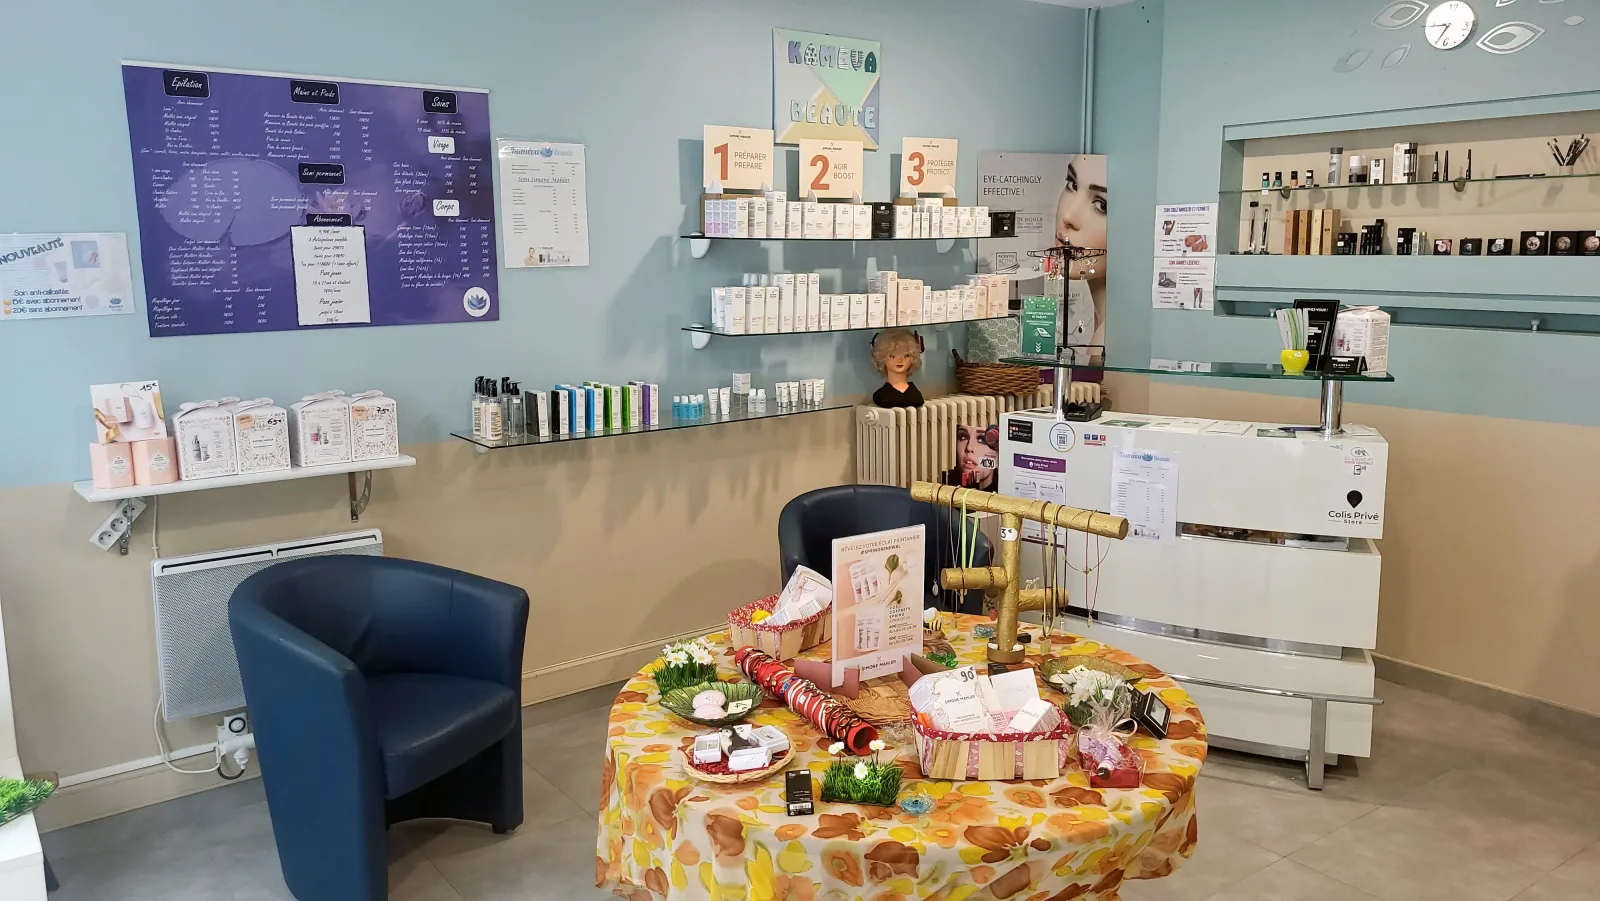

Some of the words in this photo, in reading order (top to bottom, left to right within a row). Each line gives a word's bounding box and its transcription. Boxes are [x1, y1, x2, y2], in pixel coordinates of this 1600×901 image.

[172, 77, 203, 91] Epilation
[294, 86, 310, 96] Mains
[321, 88, 336, 98] Pieds
[432, 96, 450, 108] Soins
[433, 139, 449, 151] Visage
[734, 150, 767, 161] PRÉPARER
[714, 142, 729, 181] 1
[734, 161, 763, 170] PREPARE
[833, 163, 848, 171] AGIR
[927, 158, 955, 167] PROTÉGER
[810, 154, 830, 190] 2
[907, 151, 926, 186] 3
[926, 168, 951, 176] PROTECT
[315, 170, 342, 179] permanent
[833, 172, 855, 180] BOOST
[983, 174, 1042, 185] EYE-CATCHINGLY
[983, 186, 1021, 196] EFFECTIVE
[436, 200, 455, 214] Corps
[313, 214, 343, 223] Abonnement
[14, 289, 28, 297] Soin
[43, 296, 82, 304] abonnement
[12, 306, 28, 314] 20€
[45, 304, 84, 313] abonnement
[1328, 510, 1352, 519] Colis
[1354, 511, 1380, 521] Privé
[861, 662, 879, 671] SIMONE
[879, 659, 897, 669] MAHLER
